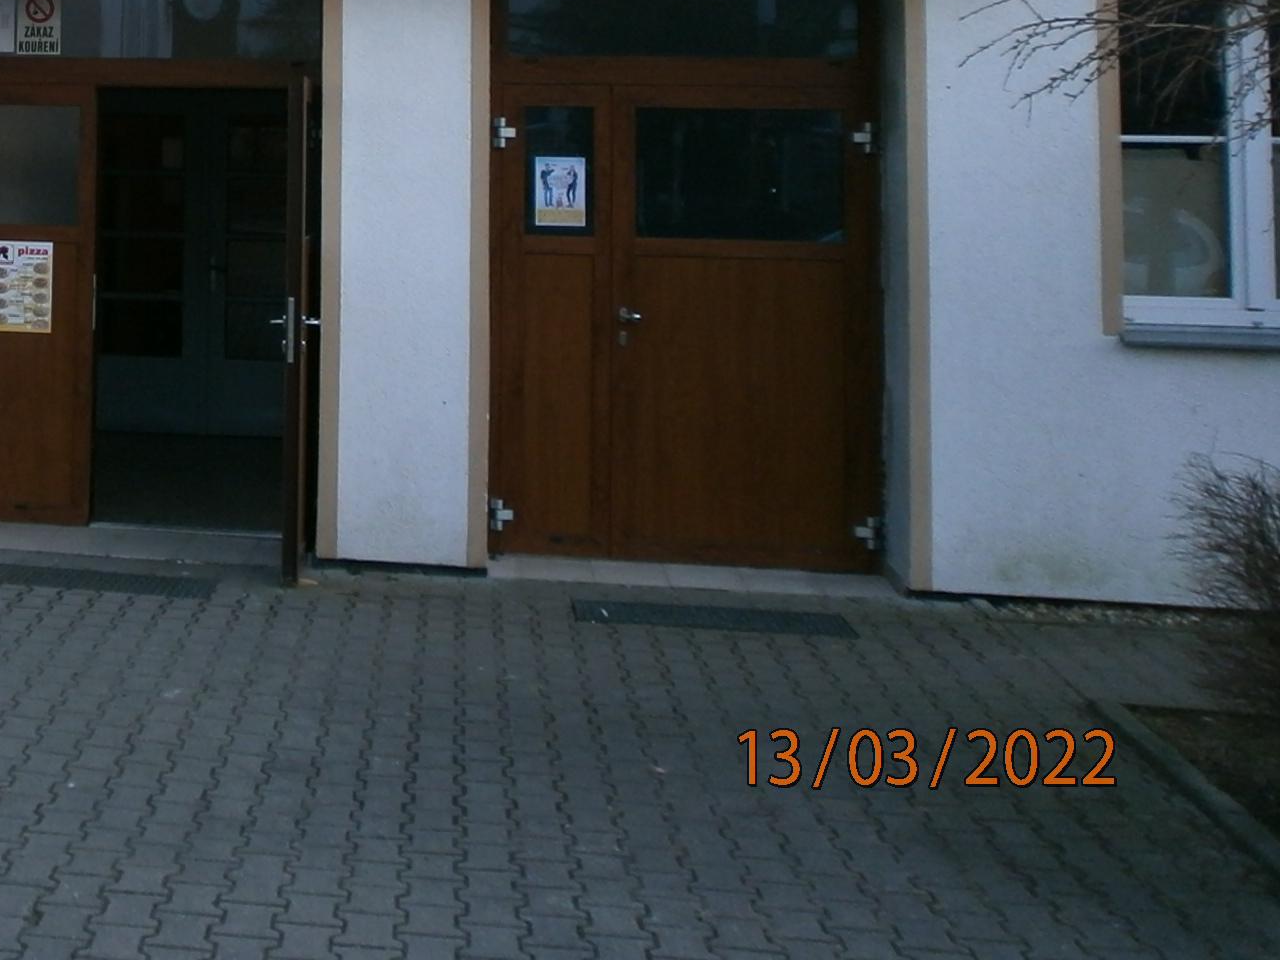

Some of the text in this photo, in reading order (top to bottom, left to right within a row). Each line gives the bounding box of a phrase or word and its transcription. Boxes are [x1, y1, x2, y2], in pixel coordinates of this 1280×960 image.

[24, 24, 54, 38] ZÁKAZ
[18, 38, 59, 53] KOUŘENÍ
[17, 245, 49, 257] pizza
